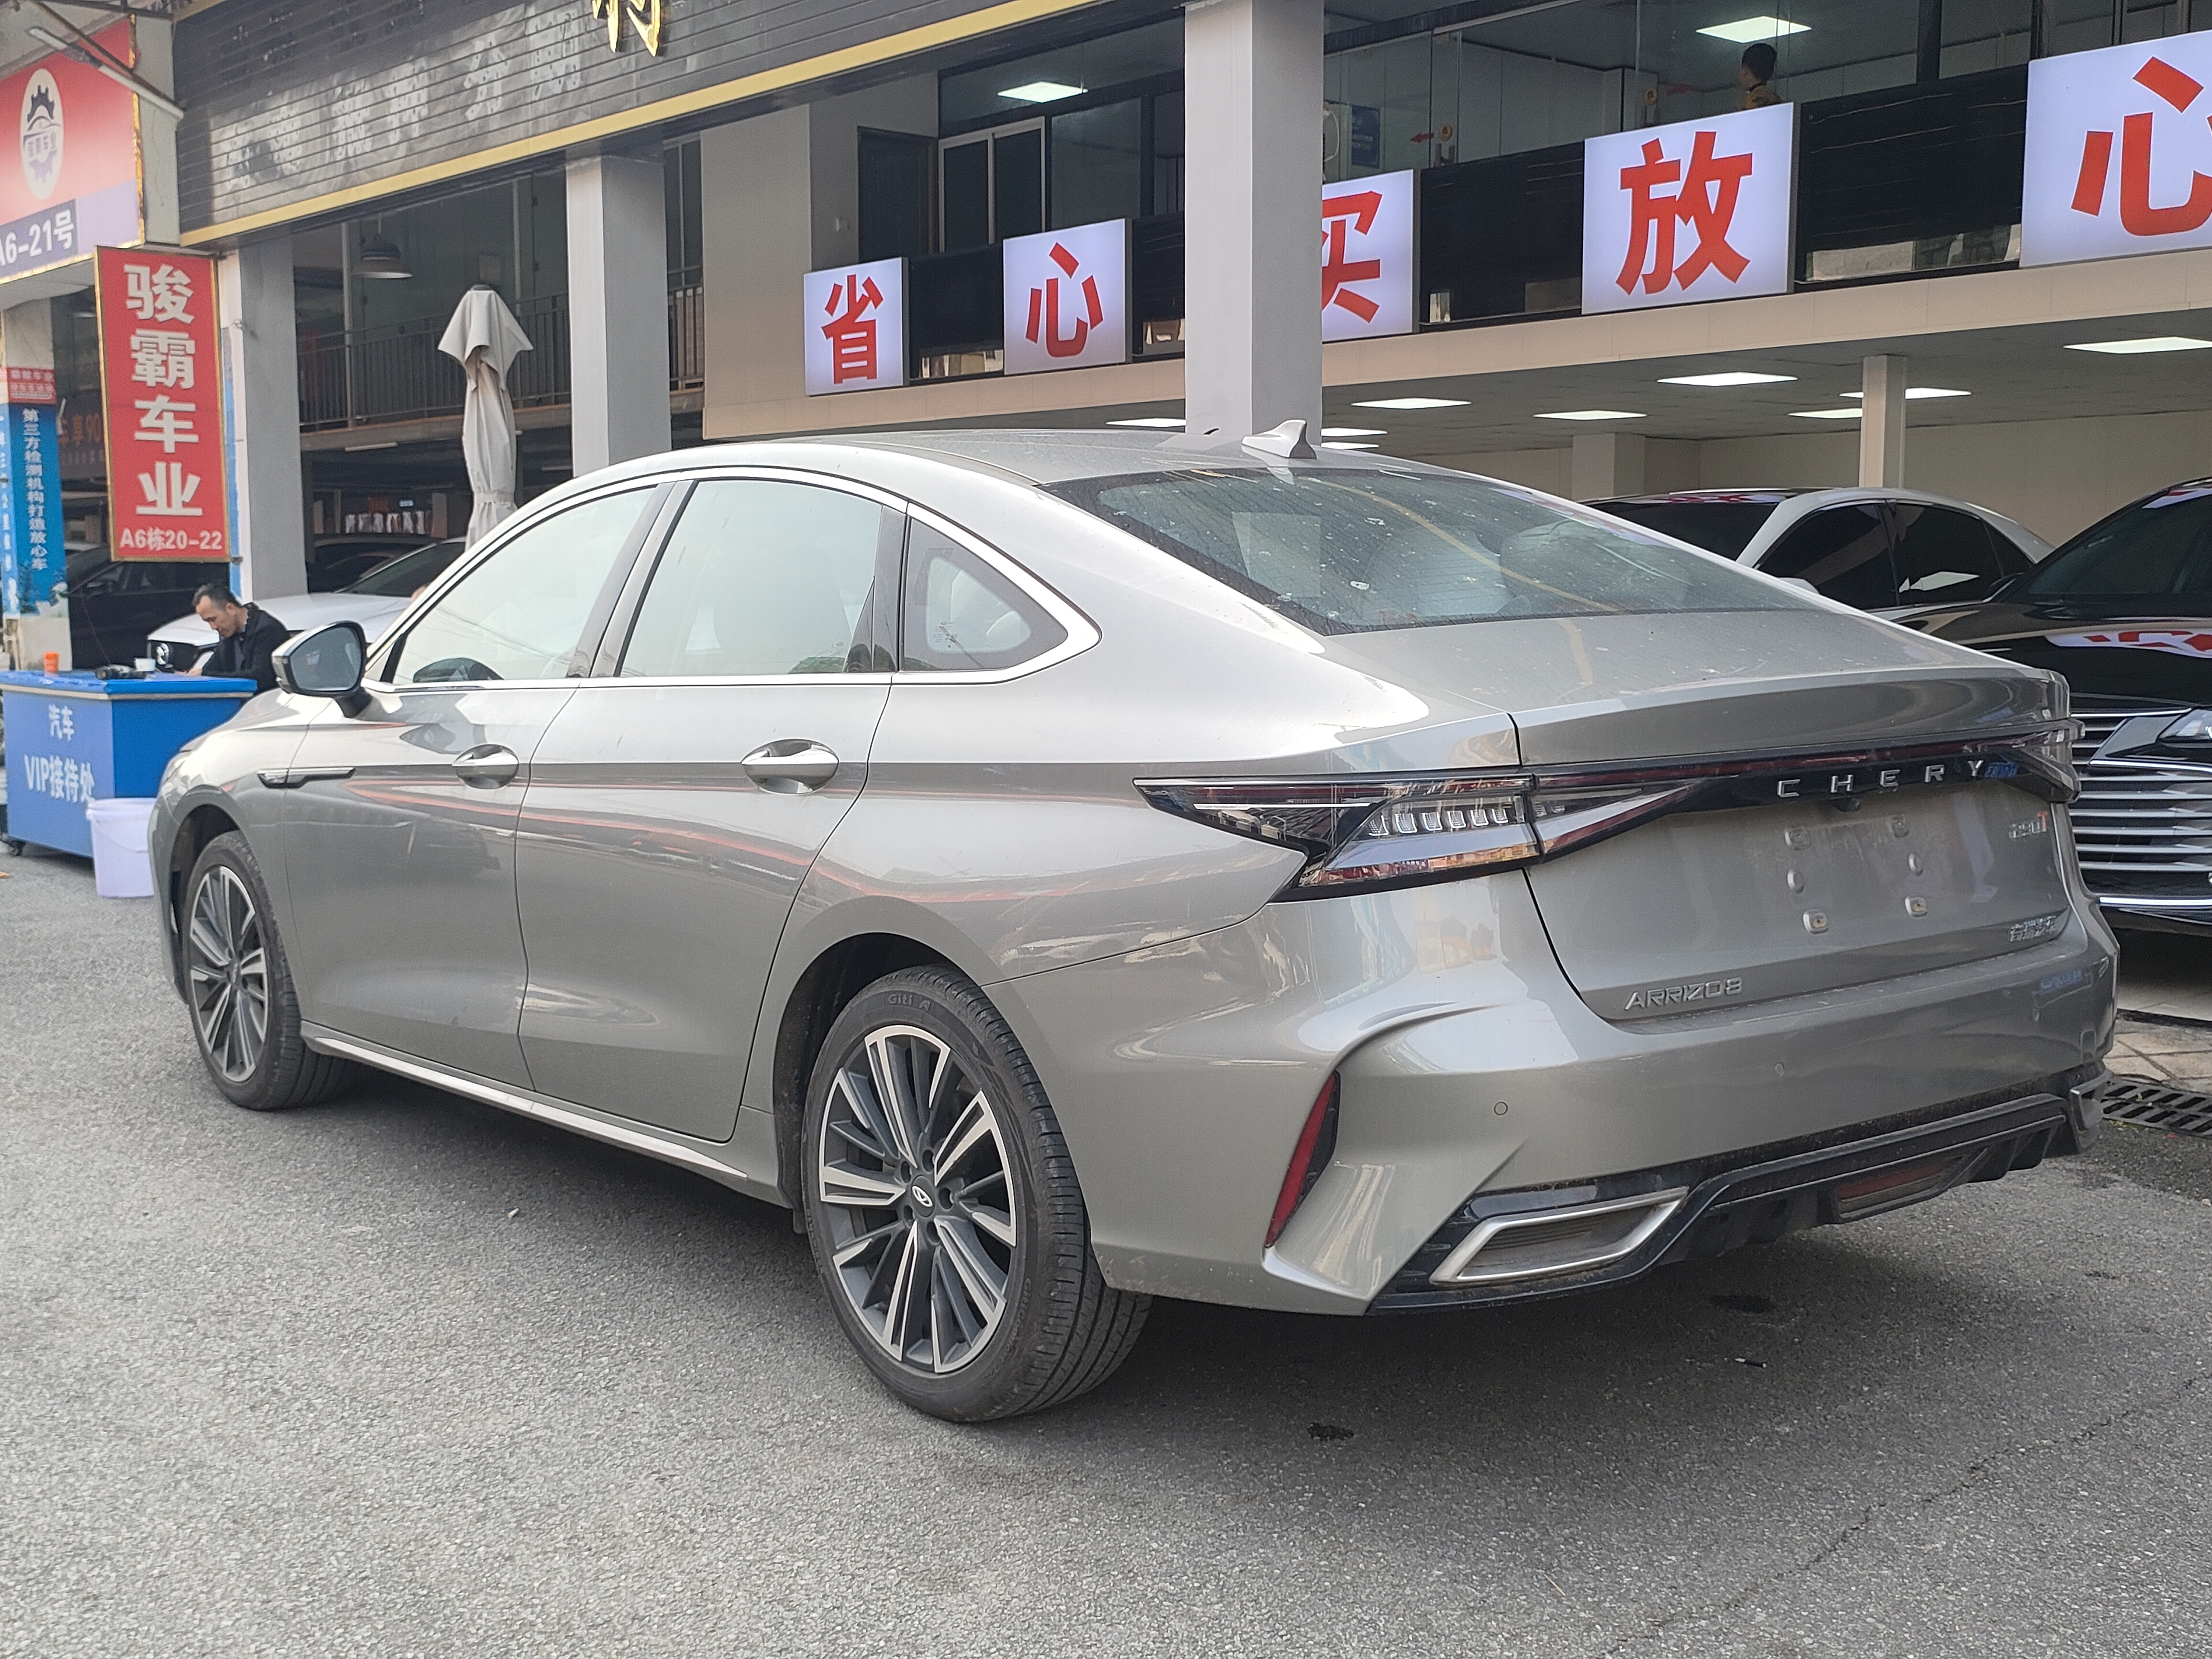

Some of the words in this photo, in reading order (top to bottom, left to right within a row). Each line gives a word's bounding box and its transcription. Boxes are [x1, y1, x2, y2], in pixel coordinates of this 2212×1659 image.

[821, 274, 884, 385] 省
[1025, 242, 1104, 358] 心
[1615, 131, 1753, 296] 放
[2071, 55, 2212, 236] 心
[123, 264, 203, 517] 骏霸车业
[120, 527, 222, 551] A6栋20-22
[48, 704, 75, 742] 汽车
[23, 754, 95, 803] VIP接待处
[1777, 760, 1984, 798] CHERY
